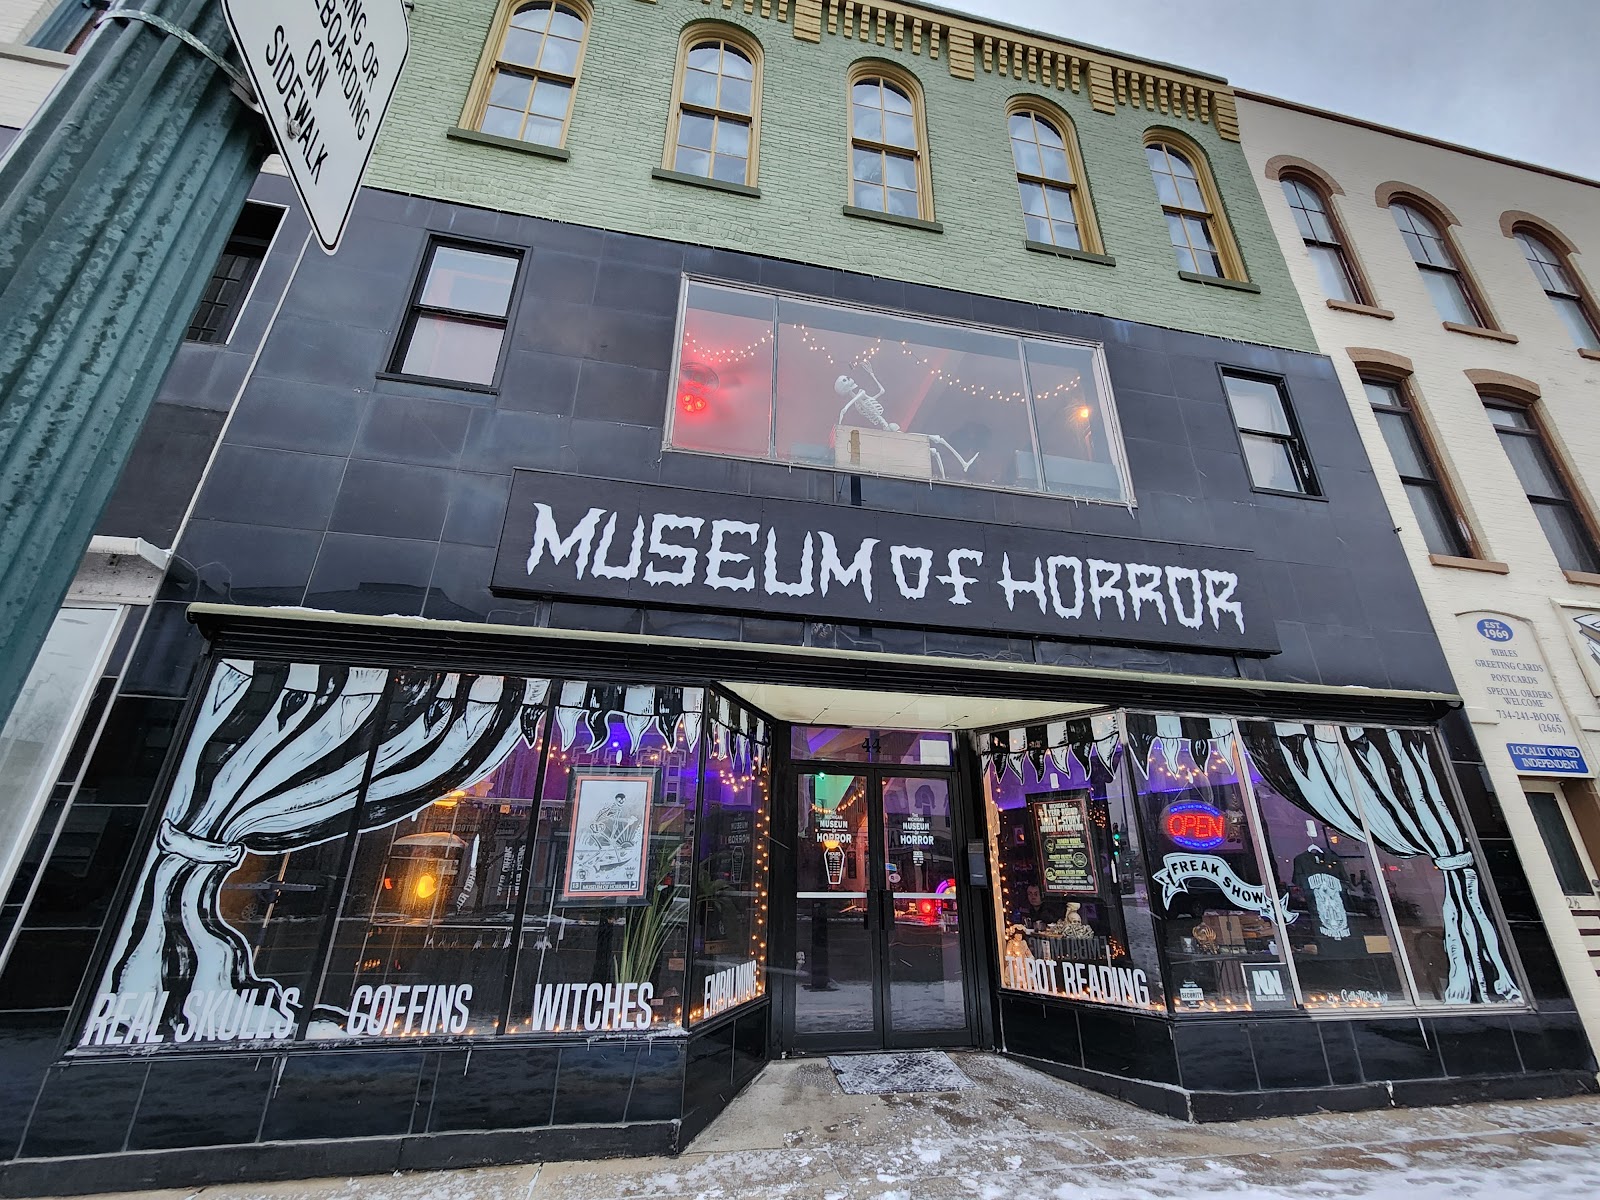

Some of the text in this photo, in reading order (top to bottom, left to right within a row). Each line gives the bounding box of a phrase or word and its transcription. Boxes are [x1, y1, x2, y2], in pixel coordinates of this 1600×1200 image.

[305, 39, 330, 99] ON
[314, 0, 370, 141] BOARDING
[361, 41, 380, 93] OR
[266, 25, 329, 186] SIDEWALK
[526, 502, 881, 603] MUSEUM
[998, 550, 1246, 634] HORROR
[1483, 628, 1510, 640] 1969
[1490, 648, 1519, 658] BIBLES
[1475, 659, 1544, 673] GREETING CARDS
[1490, 673, 1539, 685] POSTCARDS
[1486, 686, 1554, 700] SPECIAL ORDERS
[1502, 697, 1546, 708] WELCOME
[1496, 709, 1563, 723] 734-241-BOOK
[1538, 723, 1566, 736] (2665)
[861, 737, 881, 754] 44
[1510, 745, 1580, 759] LOCALLY OWNED
[1521, 757, 1580, 770] INDEPENDENT
[819, 820, 848, 829] MUSEUM
[902, 822, 930, 831] MUSEUM
[1167, 813, 1225, 839] OPEN
[816, 833, 852, 844] HORROR
[900, 834, 934, 846] HORROR
[1170, 859, 1221, 877] FREAK
[1222, 876, 1264, 905] SHOW
[1004, 955, 1151, 1008] TAROT READING
[703, 959, 758, 1020] EMBALMING
[1181, 991, 1203, 999] SECURITY
[347, 984, 476, 1034] COFFINS
[531, 981, 654, 1032] WITCHES
[82, 986, 301, 1046] REAL SKULLS
